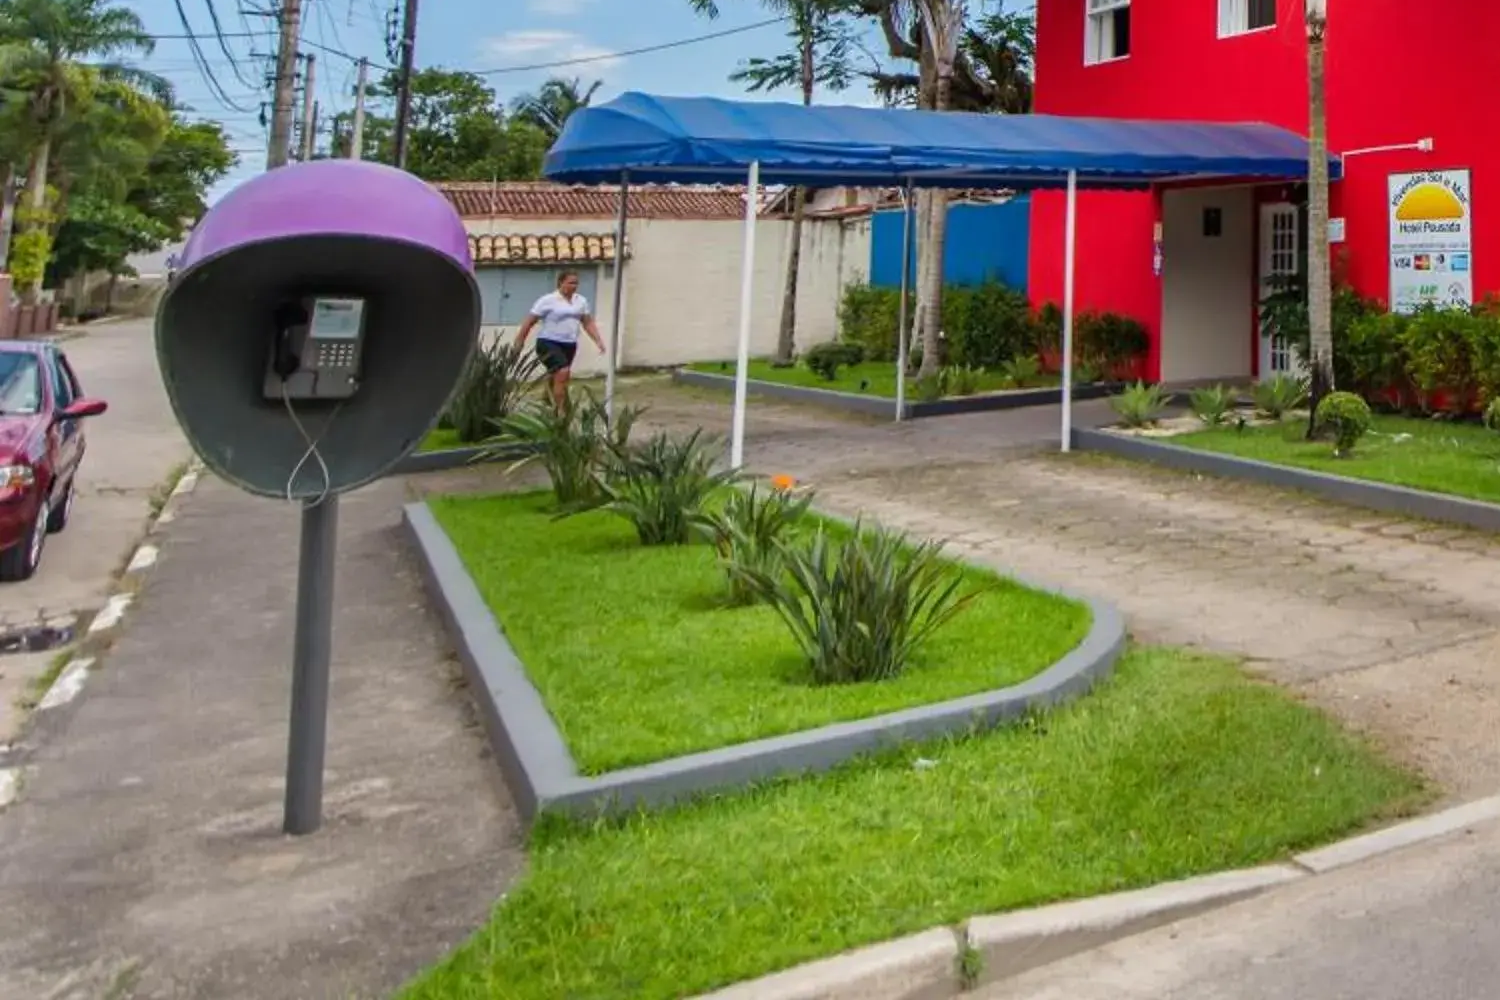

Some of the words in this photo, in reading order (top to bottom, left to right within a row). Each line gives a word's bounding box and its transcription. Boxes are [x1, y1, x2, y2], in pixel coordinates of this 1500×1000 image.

[1400, 222, 1421, 233] Hotel
[1423, 221, 1461, 233] Pousada
[1393, 256, 1411, 269] VISA
